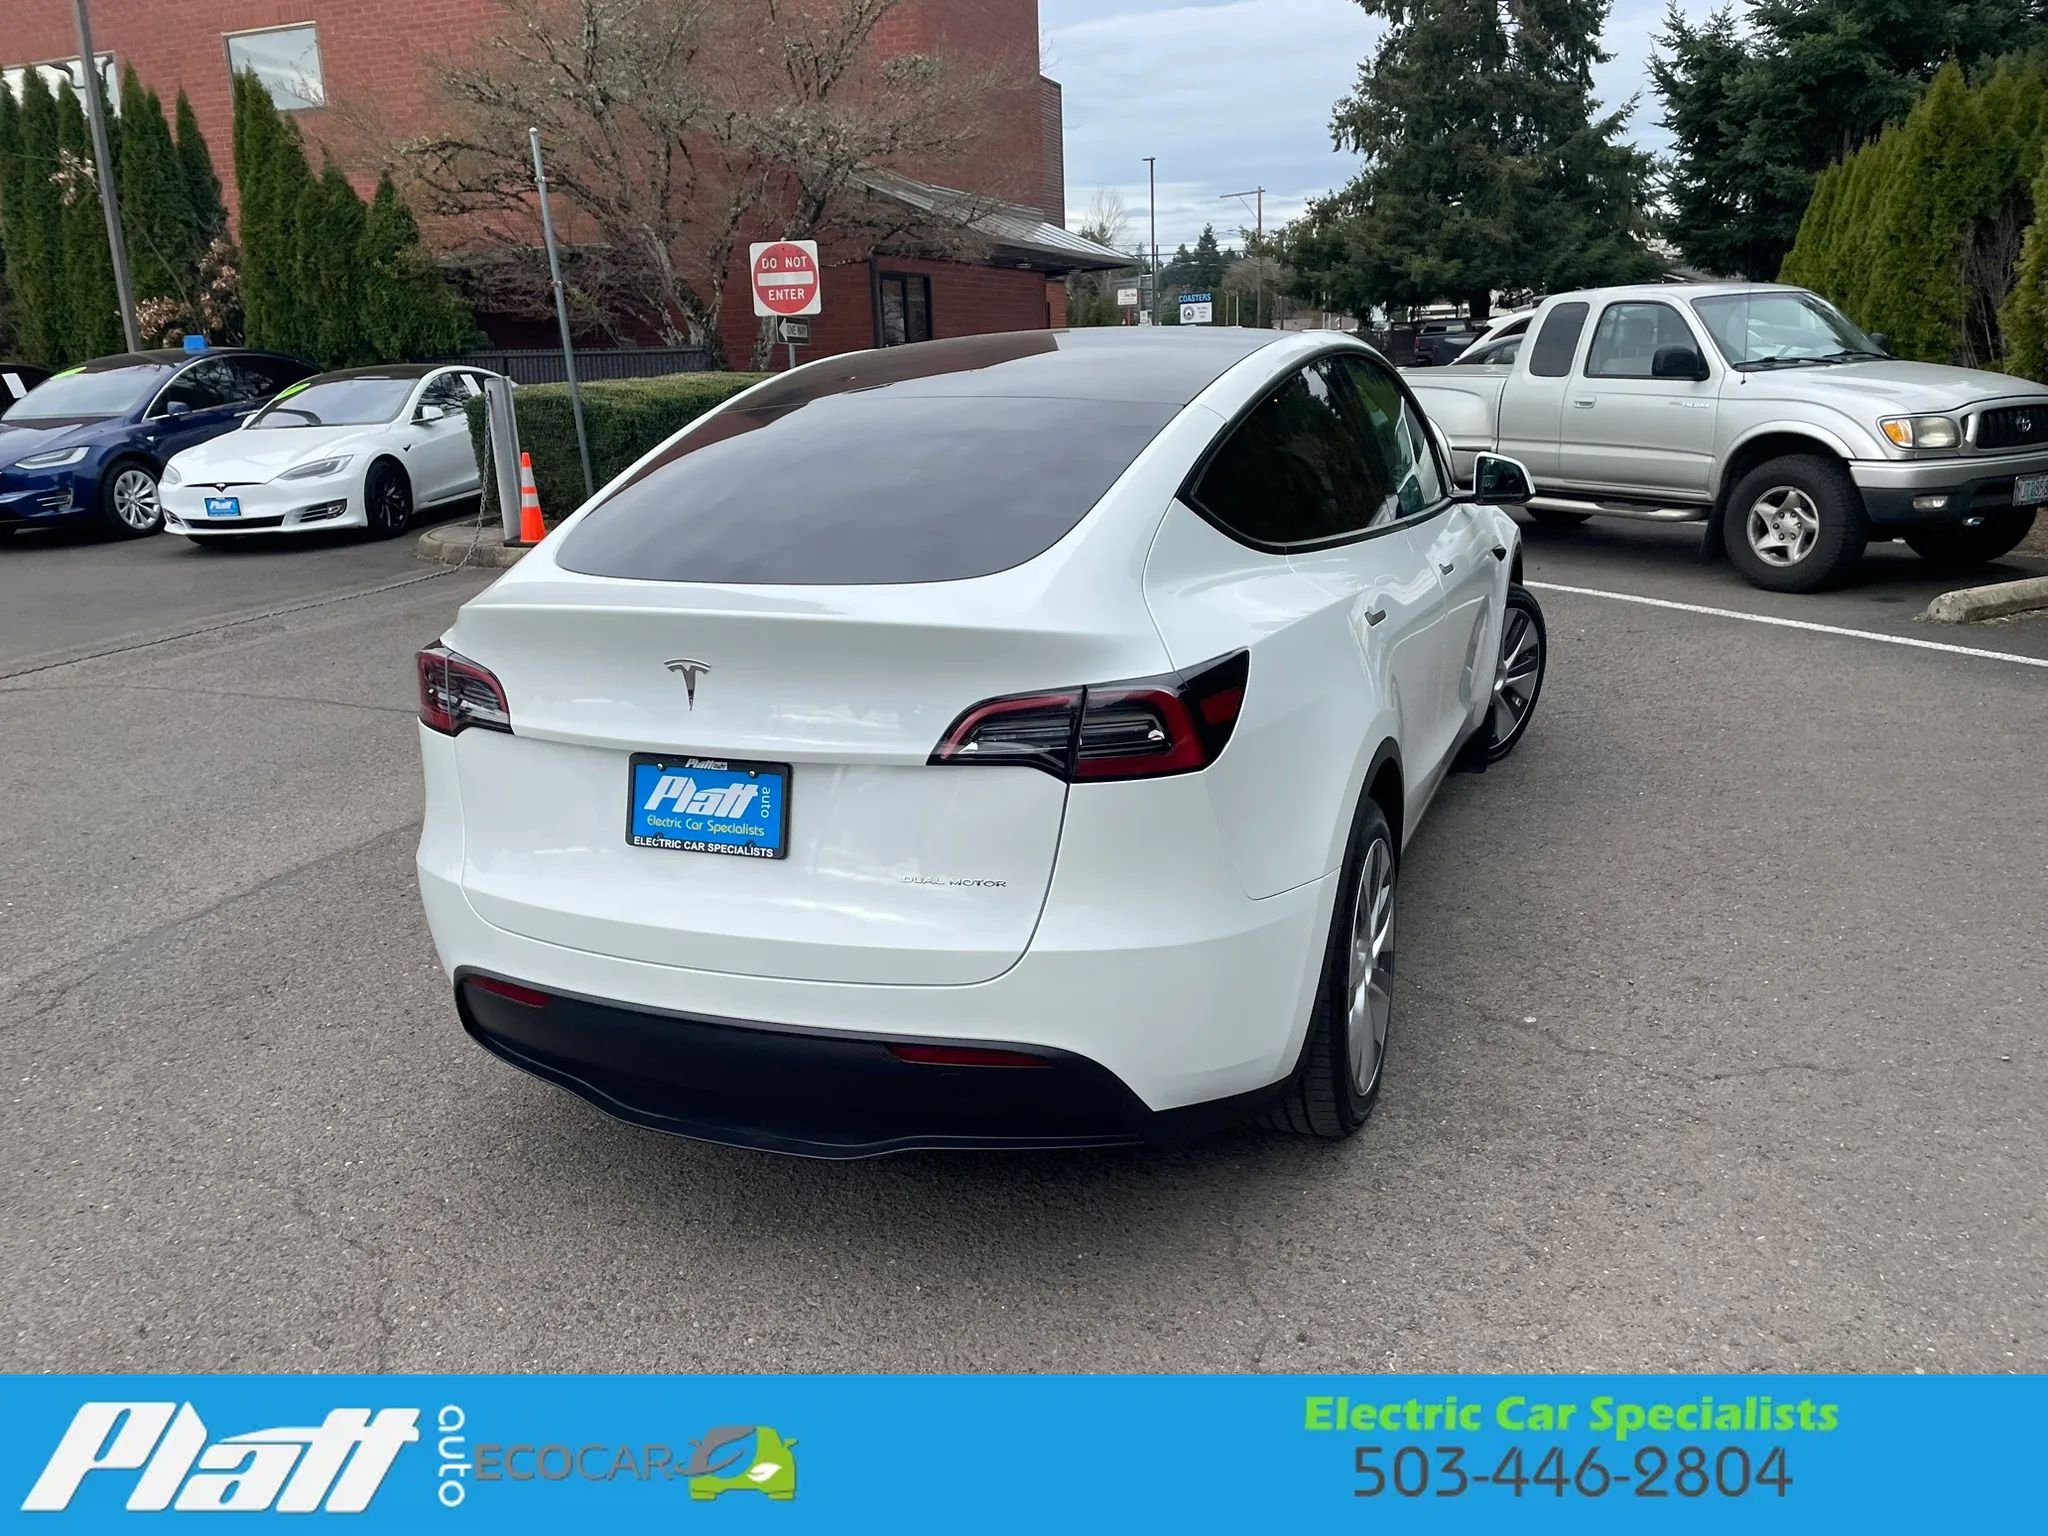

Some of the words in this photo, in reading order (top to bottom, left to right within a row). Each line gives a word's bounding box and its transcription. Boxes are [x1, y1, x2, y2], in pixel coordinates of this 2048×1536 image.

[762, 258, 777, 269] DO
[785, 256, 807, 268] NOT
[768, 288, 805, 300] ENTER
[1179, 293, 1211, 302] COASTERS
[643, 775, 759, 819] Platt
[761, 786, 771, 819] auto
[647, 814, 682, 829] Electric
[685, 818, 703, 831] Car
[707, 820, 765, 836] Specialists
[633, 836, 682, 850] ELECTRIC
[685, 841, 706, 852] CAR
[707, 843, 773, 858] SPECIALISTS
[902, 876, 945, 886] DUAL
[949, 879, 1007, 888] MOTOR
